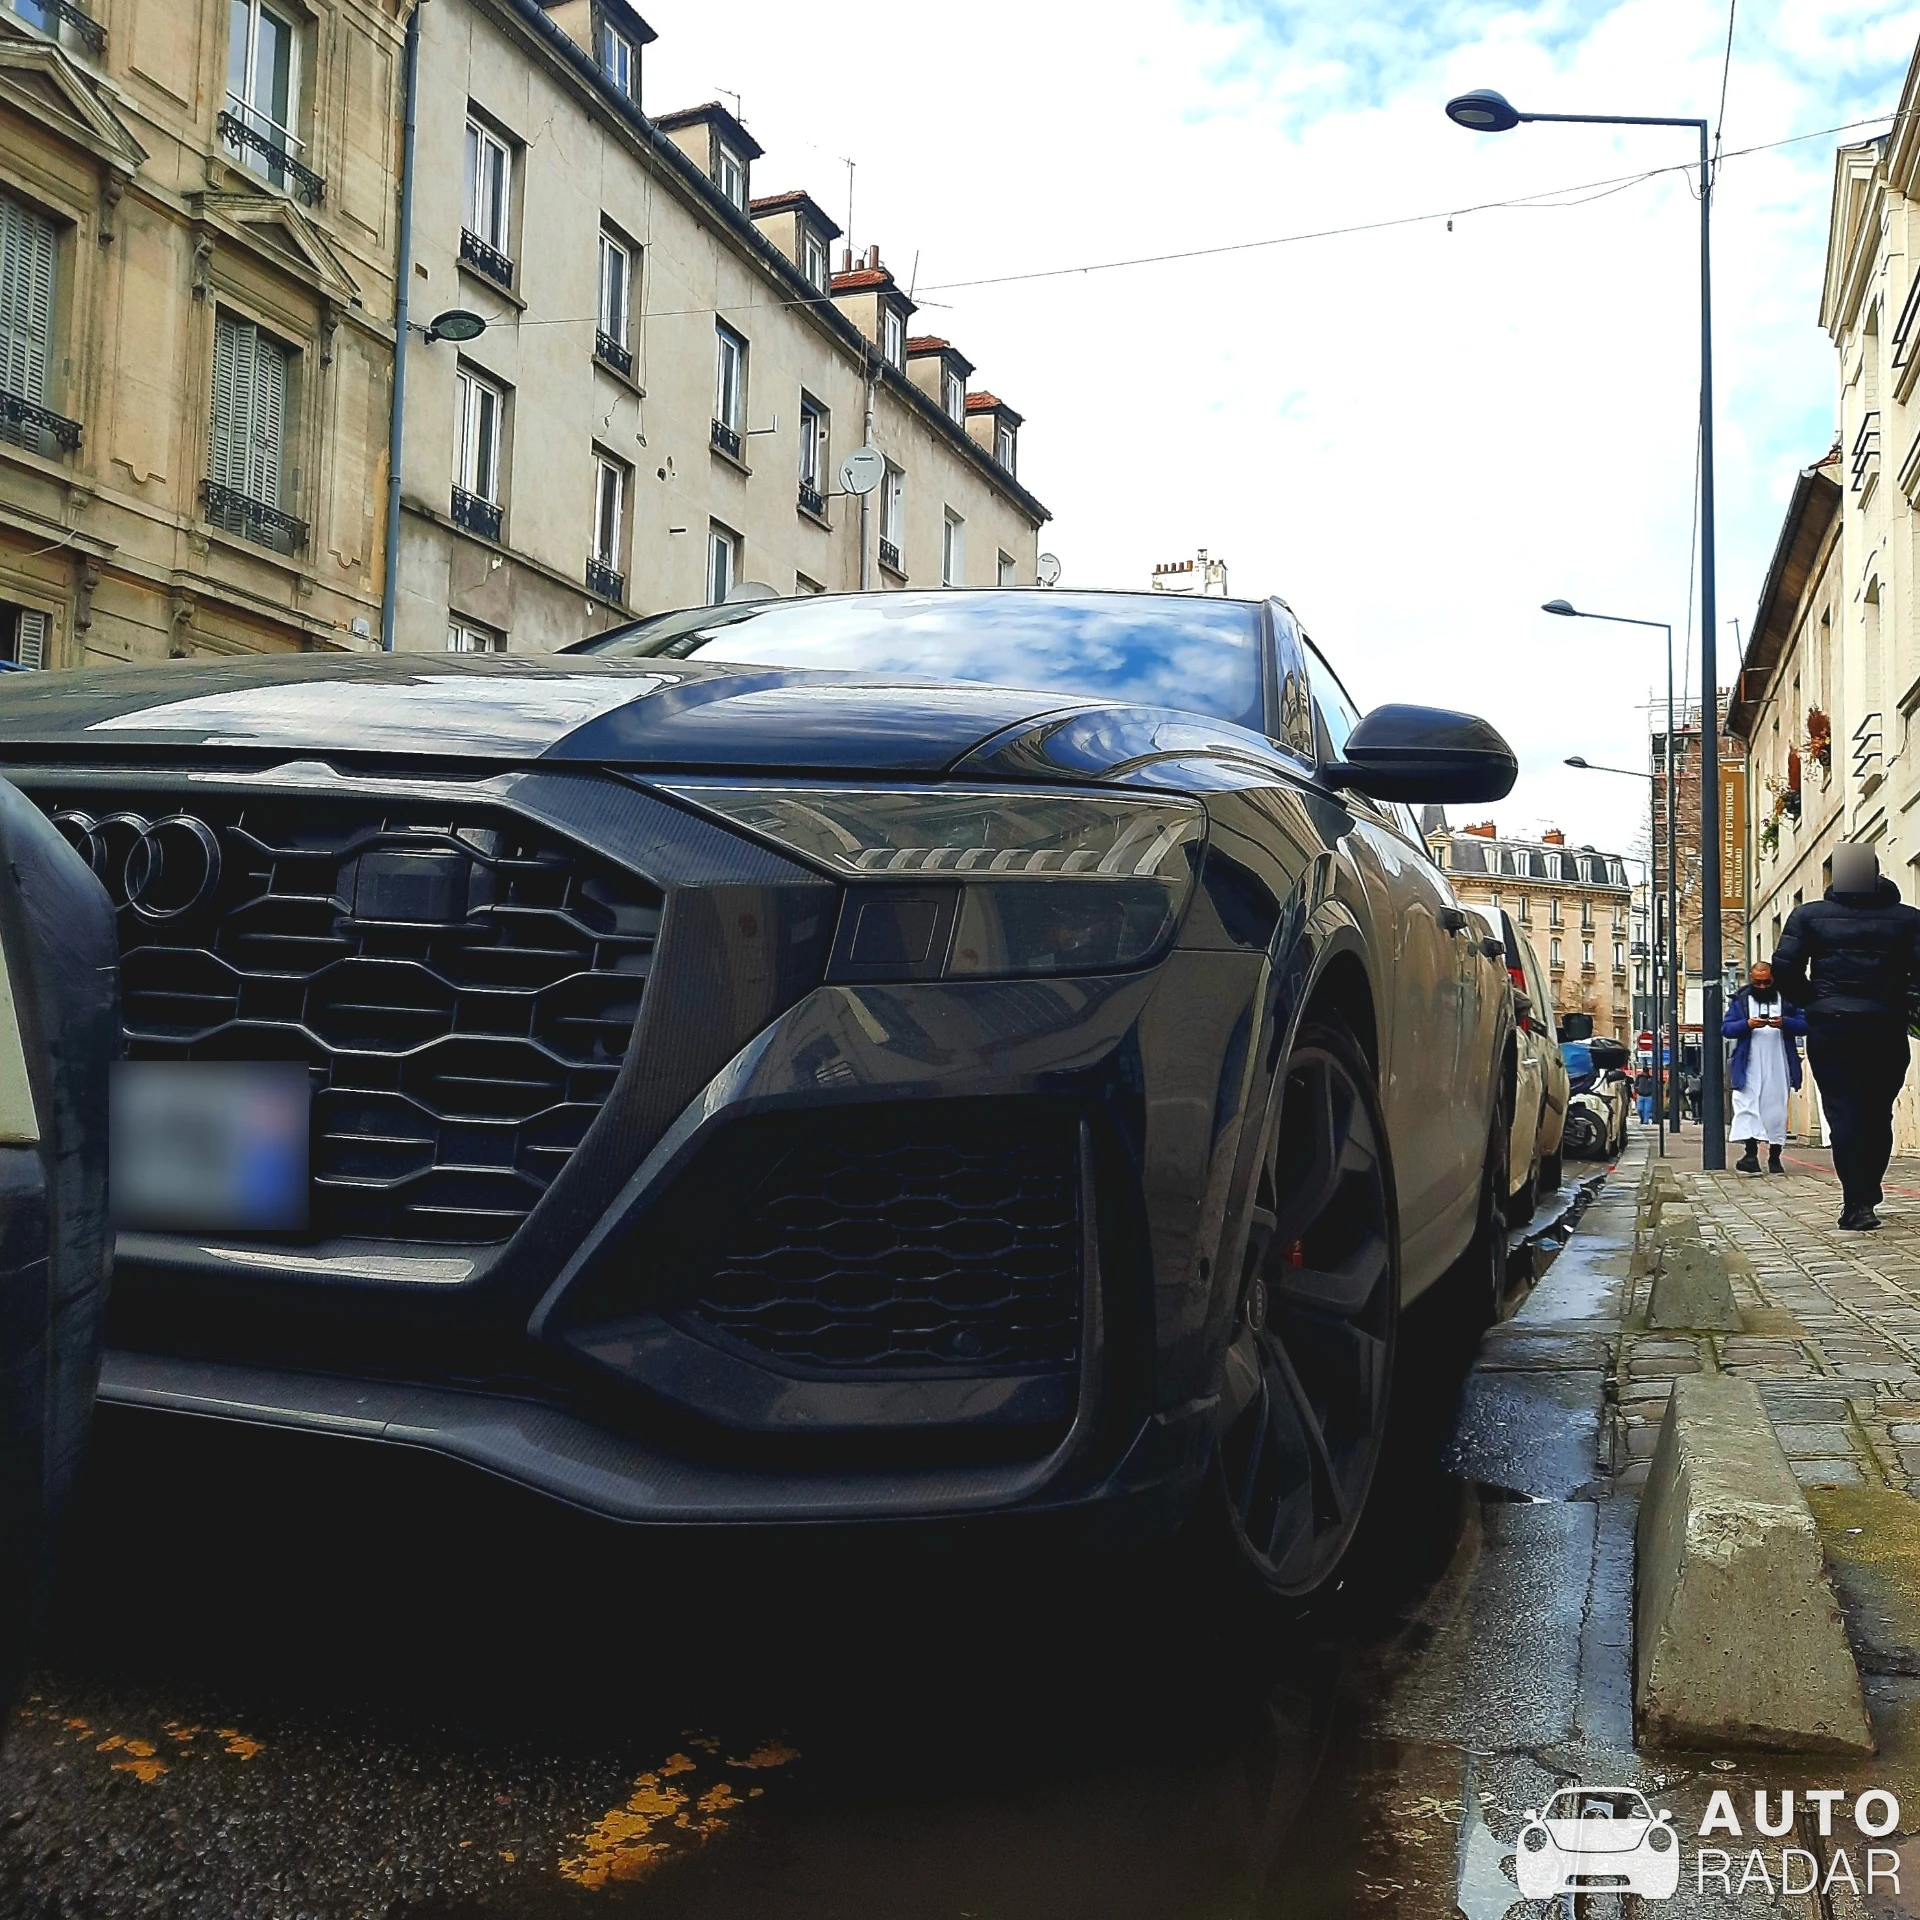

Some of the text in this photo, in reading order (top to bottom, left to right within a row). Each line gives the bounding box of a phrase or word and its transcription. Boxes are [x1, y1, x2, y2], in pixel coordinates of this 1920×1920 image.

[1725, 782, 1734, 829] D'HISTOIRE
[1725, 830, 1733, 841] ET
[1725, 842, 1733, 868] D'ART
[1723, 869, 1733, 898] MUSÉE
[1735, 879, 1743, 898] PAUL
